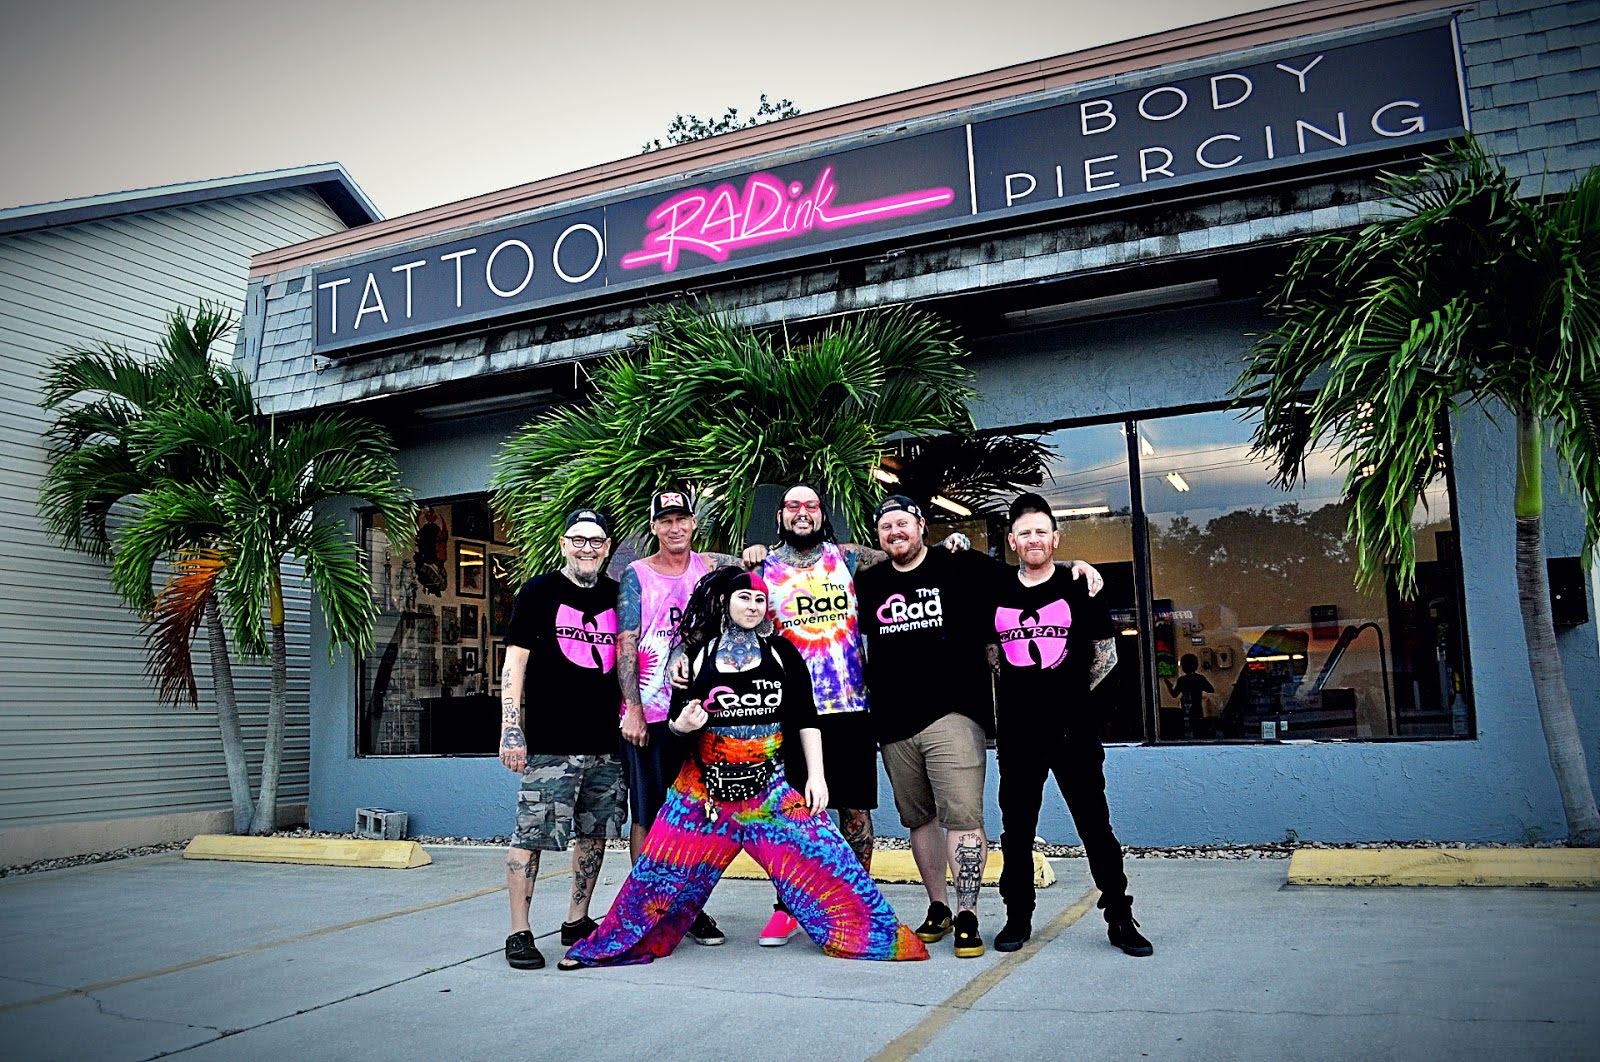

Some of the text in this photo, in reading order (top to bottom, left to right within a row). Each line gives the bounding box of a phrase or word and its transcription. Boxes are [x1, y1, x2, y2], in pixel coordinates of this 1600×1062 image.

[1080, 55, 1323, 136] BODY
[1005, 101, 1425, 207] PIERCING
[318, 223, 604, 335] TATTOO
[822, 583, 845, 592] The
[915, 587, 940, 599] The
[796, 591, 849, 616] Rad
[891, 595, 943, 623] Rad
[781, 611, 849, 628] movement
[880, 616, 944, 635] movement
[588, 631, 617, 645] RA
[1026, 626, 1069, 638] RAD
[751, 679, 782, 690] The
[716, 688, 783, 710] Rad
